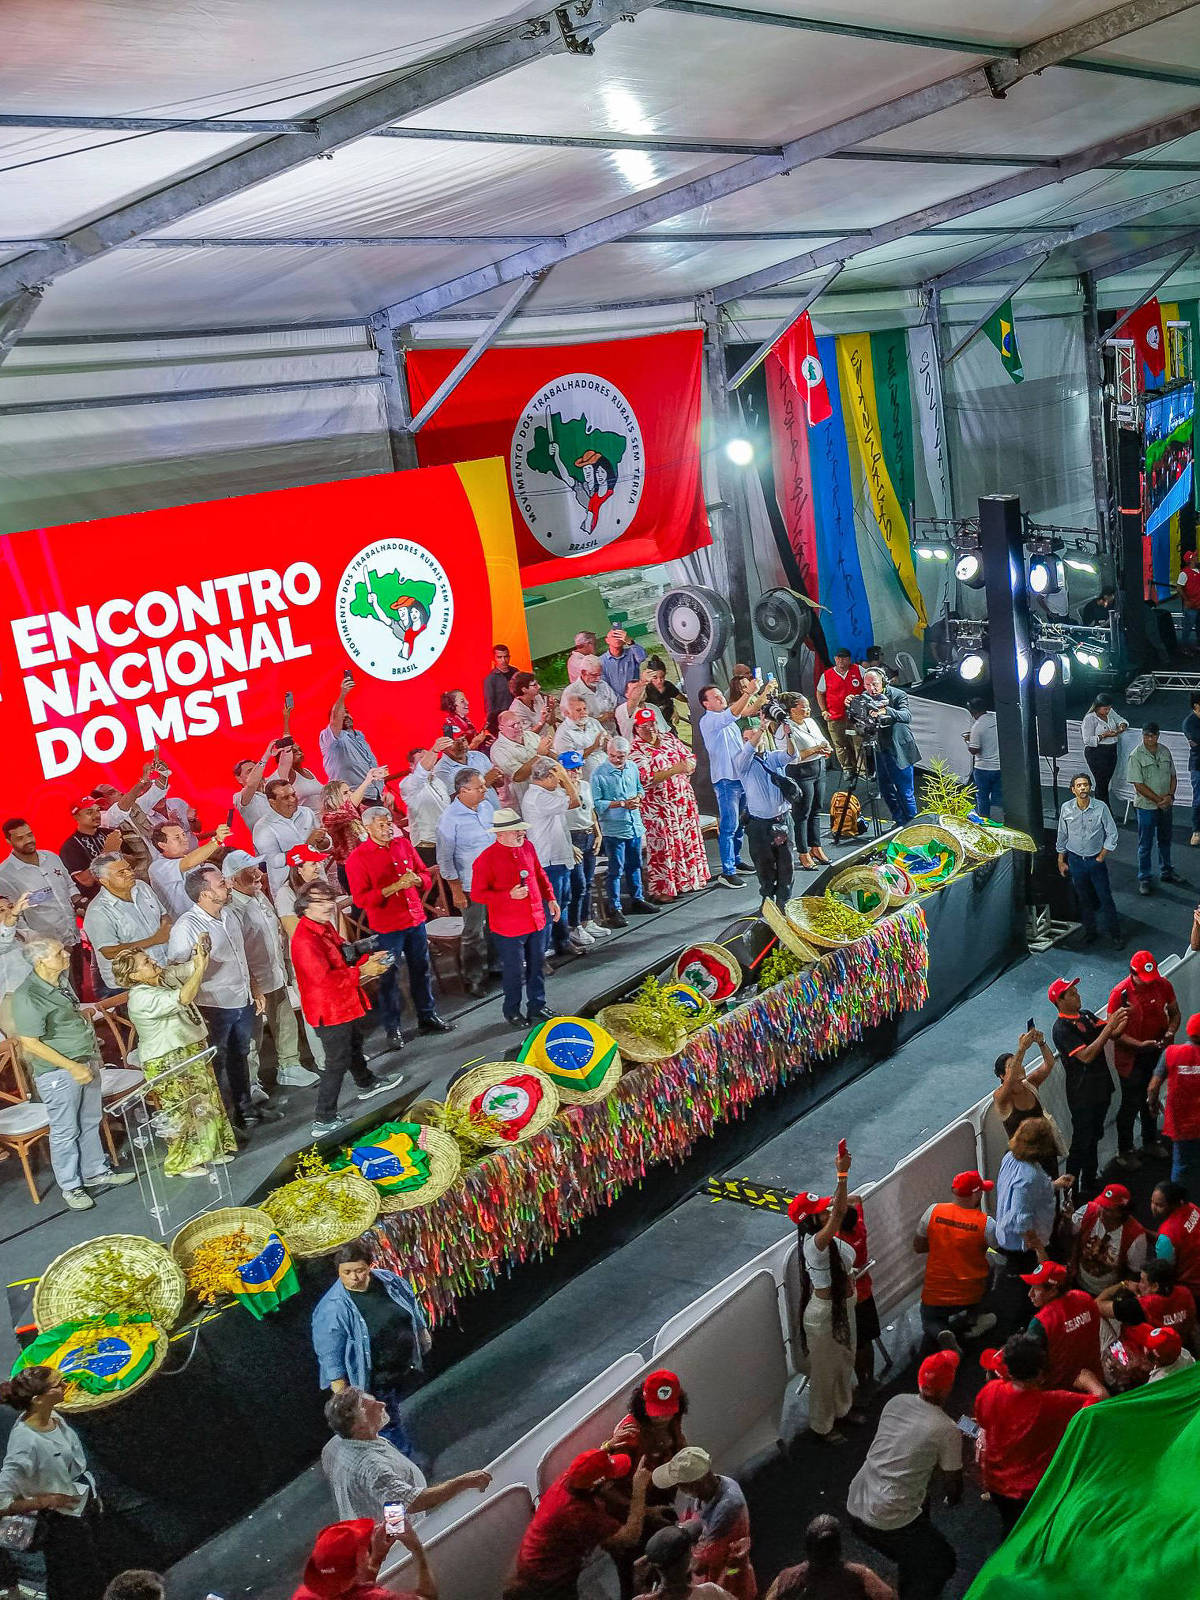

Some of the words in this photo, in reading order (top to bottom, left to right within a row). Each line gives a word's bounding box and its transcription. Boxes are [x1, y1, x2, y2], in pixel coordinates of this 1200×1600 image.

[533, 379, 612, 412] TRABALHADORES
[519, 413, 534, 438] DOS
[611, 393, 635, 433] RURAIS
[631, 436, 640, 462] SEM
[514, 443, 537, 524] MOVIMENTO
[628, 467, 641, 505] TERRA
[352, 543, 418, 572] TRABALHADORES
[568, 538, 599, 552] BRASIL
[420, 552, 443, 582] RURAIS
[342, 573, 354, 593] DOS
[440, 583, 449, 603] SEM
[10, 561, 322, 669] ENCONTRO
[340, 597, 361, 657] MOVIMENTO
[439, 607, 450, 636] TERRA
[23, 617, 313, 725] NACIONAL
[391, 663, 419, 675] BRASIL
[35, 714, 128, 780] DO
[135, 679, 249, 752] MST
